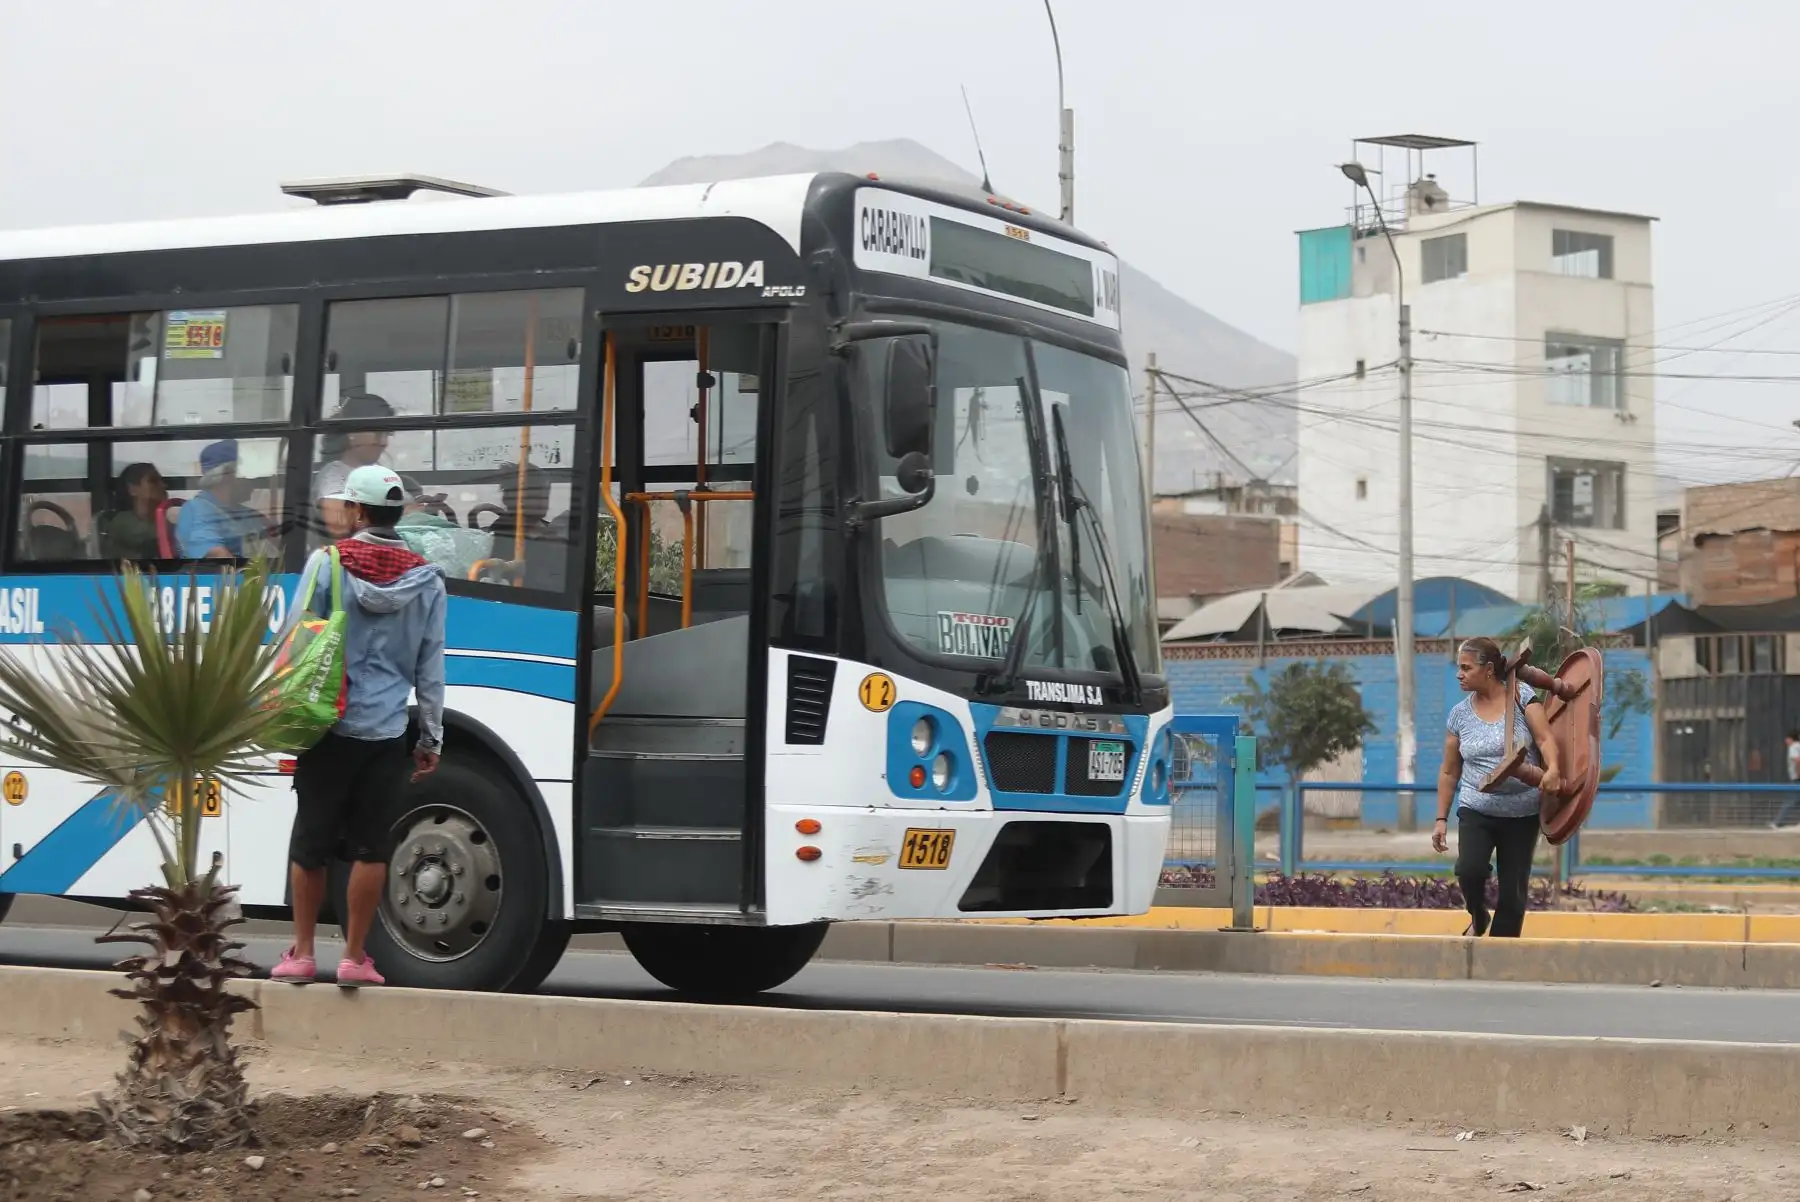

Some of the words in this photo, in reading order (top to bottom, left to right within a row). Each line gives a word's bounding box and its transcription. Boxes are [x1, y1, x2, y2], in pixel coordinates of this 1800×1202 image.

[862, 207, 927, 260] CARABAYLLO
[625, 260, 764, 293] SUBIDA
[761, 286, 806, 298] APOLO
[953, 613, 1009, 627] TODO
[1026, 680, 1085, 704] TRANSLIMA
[906, 833, 951, 865] 1518
